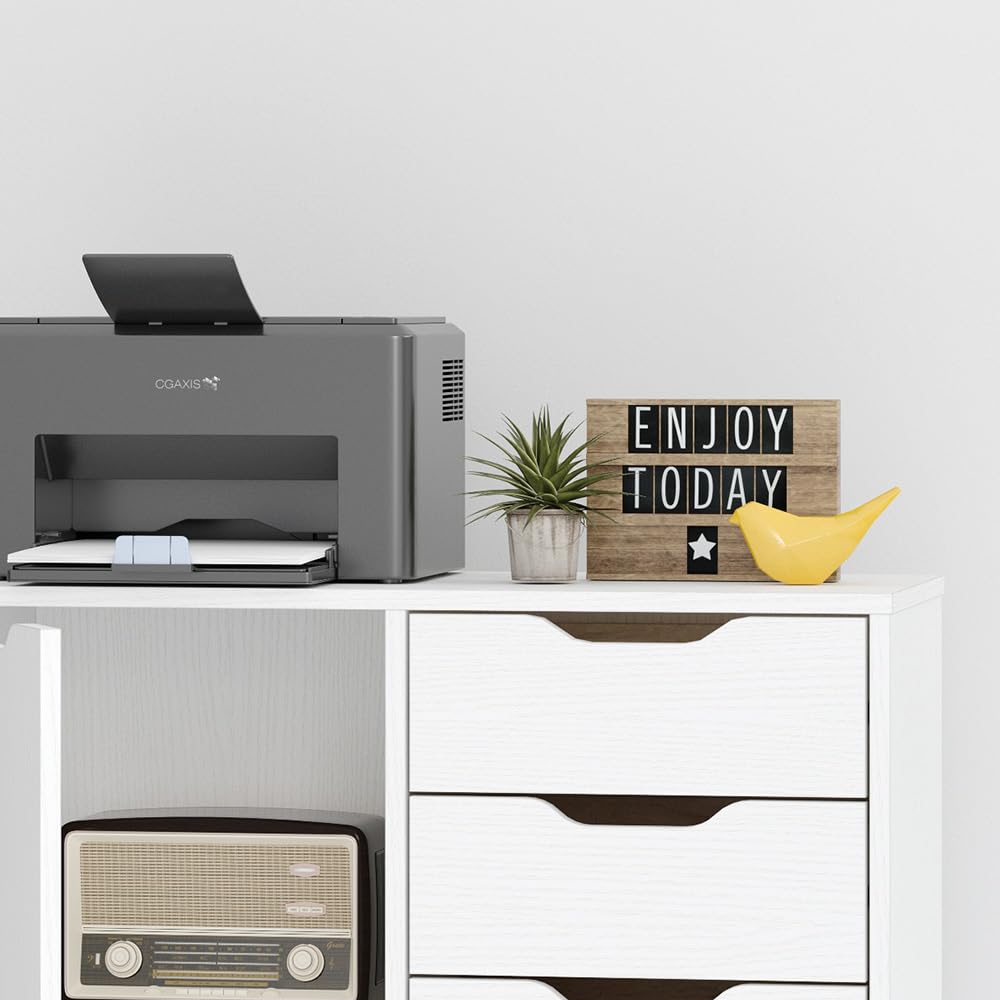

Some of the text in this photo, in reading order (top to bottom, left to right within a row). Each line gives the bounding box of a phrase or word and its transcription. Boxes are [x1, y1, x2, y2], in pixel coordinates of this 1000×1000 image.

[155, 378, 201, 390] CGAXIS
[634, 406, 788, 451] ENJOY
[627, 466, 782, 511] TODAY
